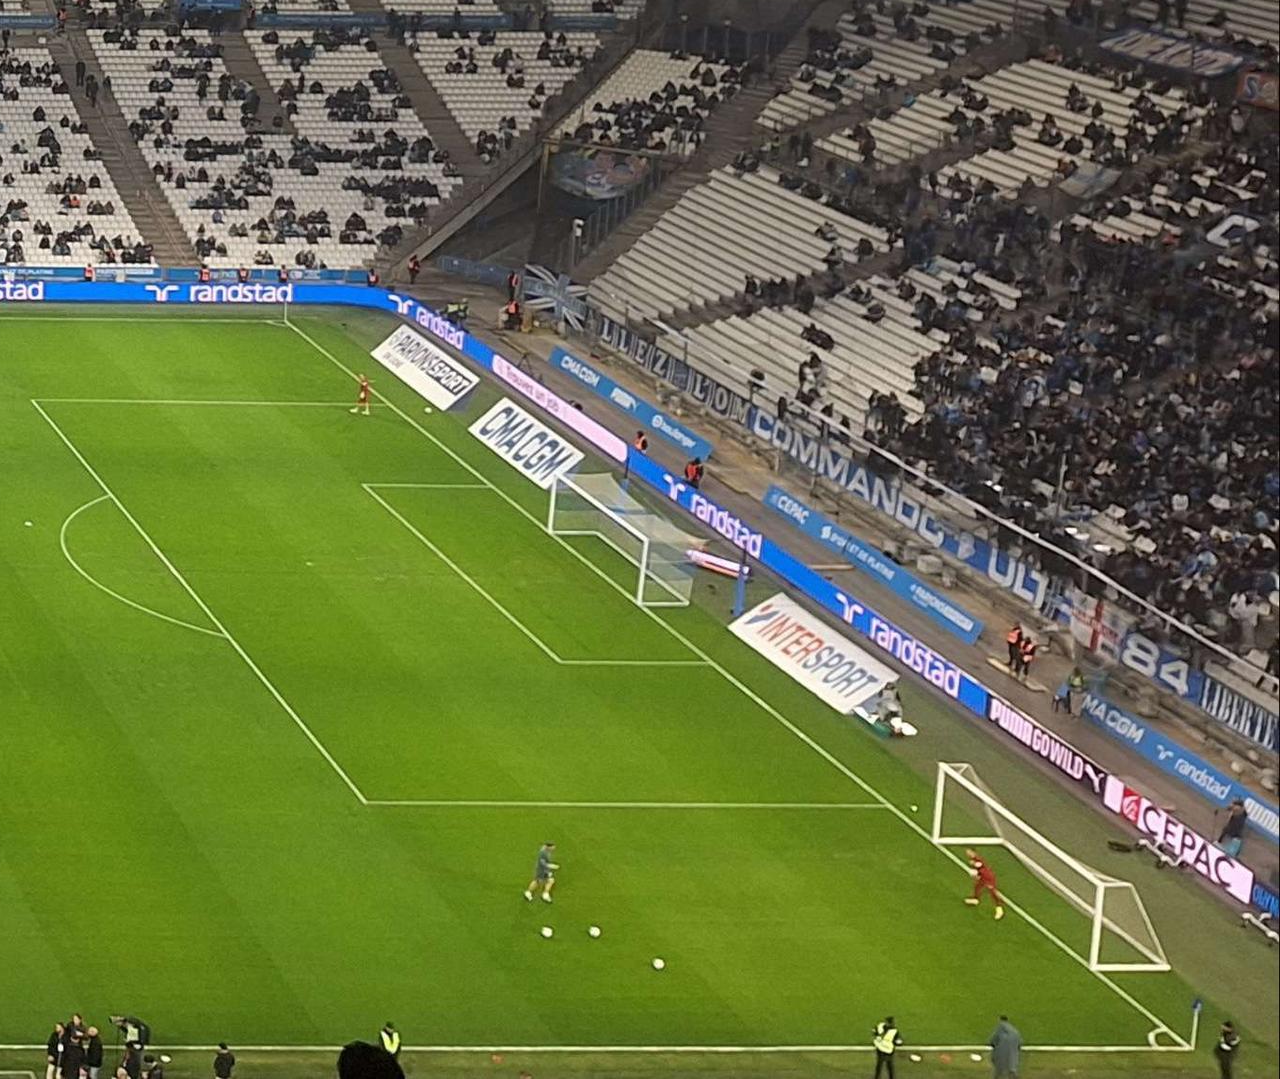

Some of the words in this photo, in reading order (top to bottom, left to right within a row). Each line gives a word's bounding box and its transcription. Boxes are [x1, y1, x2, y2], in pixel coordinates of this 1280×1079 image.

[190, 283, 293, 302] randstad
[479, 406, 534, 454] CMA
[691, 495, 763, 559] randstad
[757, 613, 879, 699] INTERSPORT
[870, 616, 961, 699] randstad
[1120, 631, 1190, 697] 84
[991, 698, 1033, 747] PUMA
[1032, 726, 1050, 759] GO
[1049, 736, 1085, 781] WILD
[1174, 757, 1232, 800] randstad
[1143, 805, 1236, 890] CEPAC
